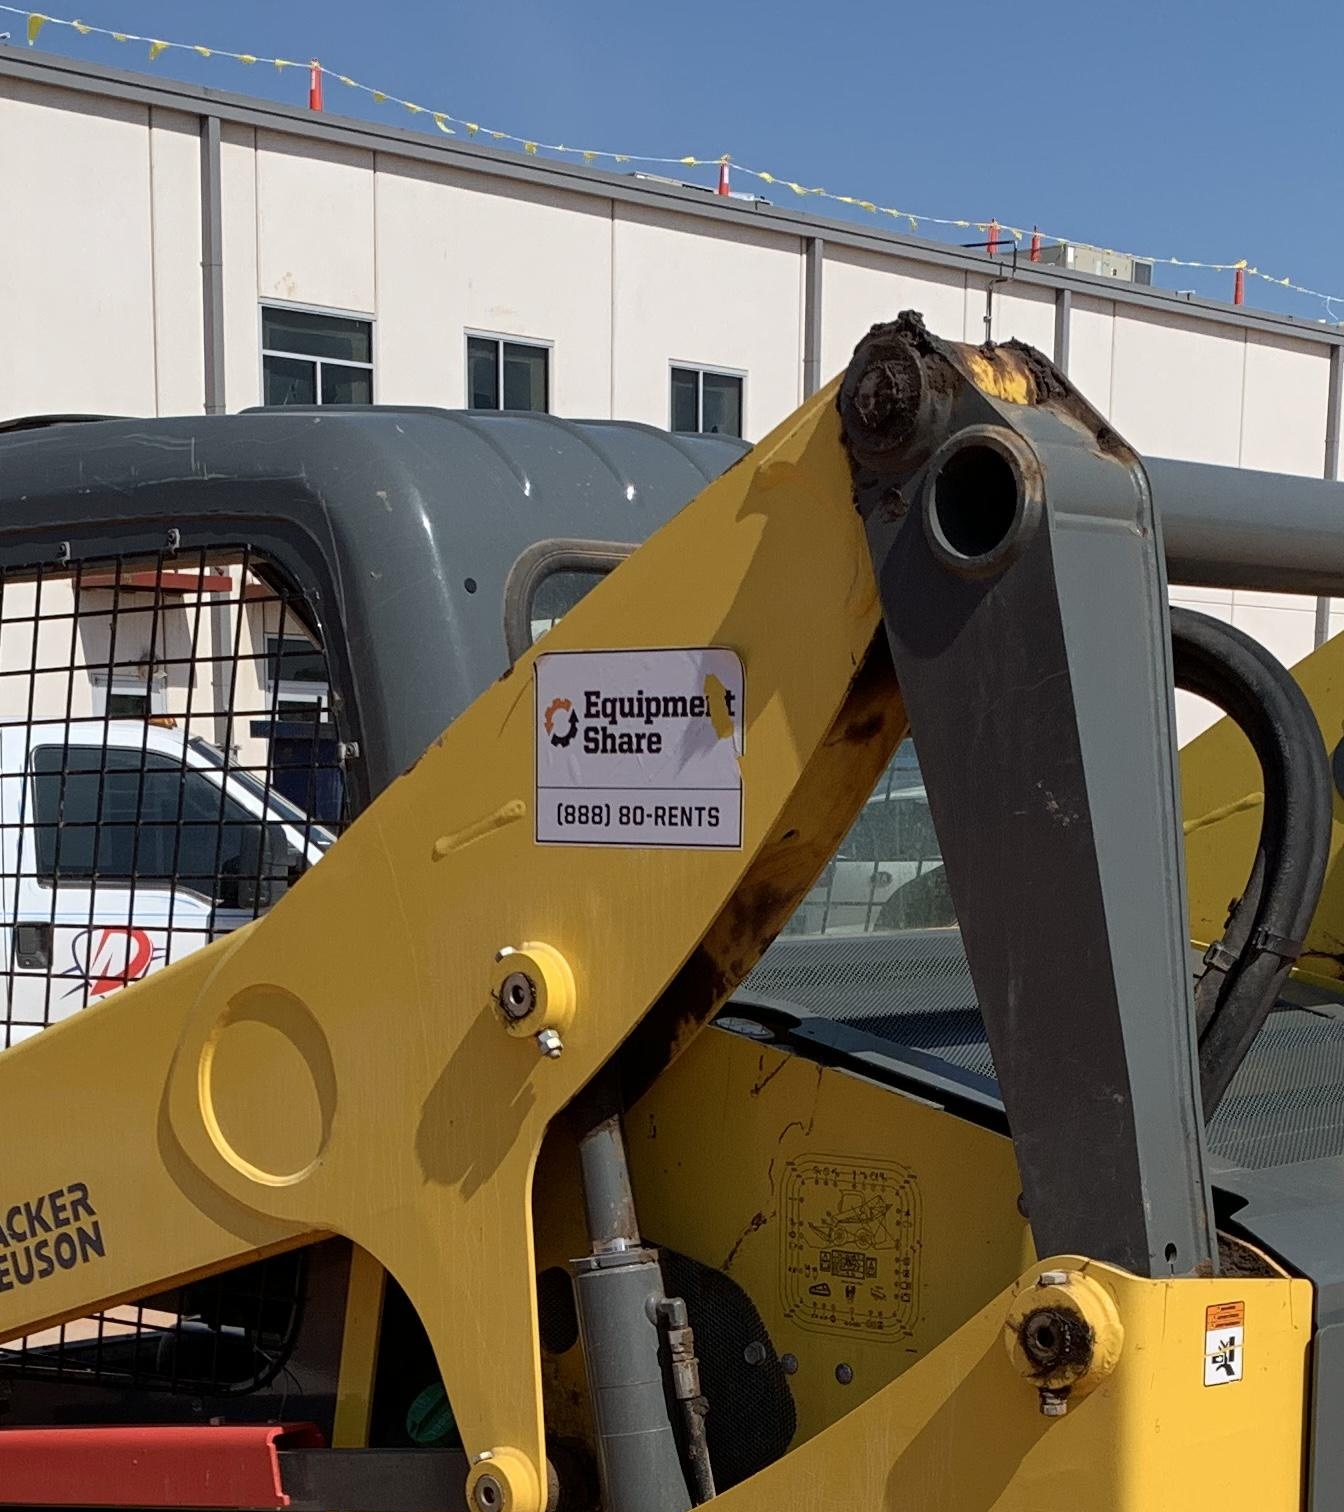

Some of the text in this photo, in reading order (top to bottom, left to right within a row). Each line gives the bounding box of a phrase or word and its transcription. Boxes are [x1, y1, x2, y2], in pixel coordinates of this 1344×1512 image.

[584, 726, 662, 754] Share
[557, 803, 720, 827] (888) 80-RENTS
